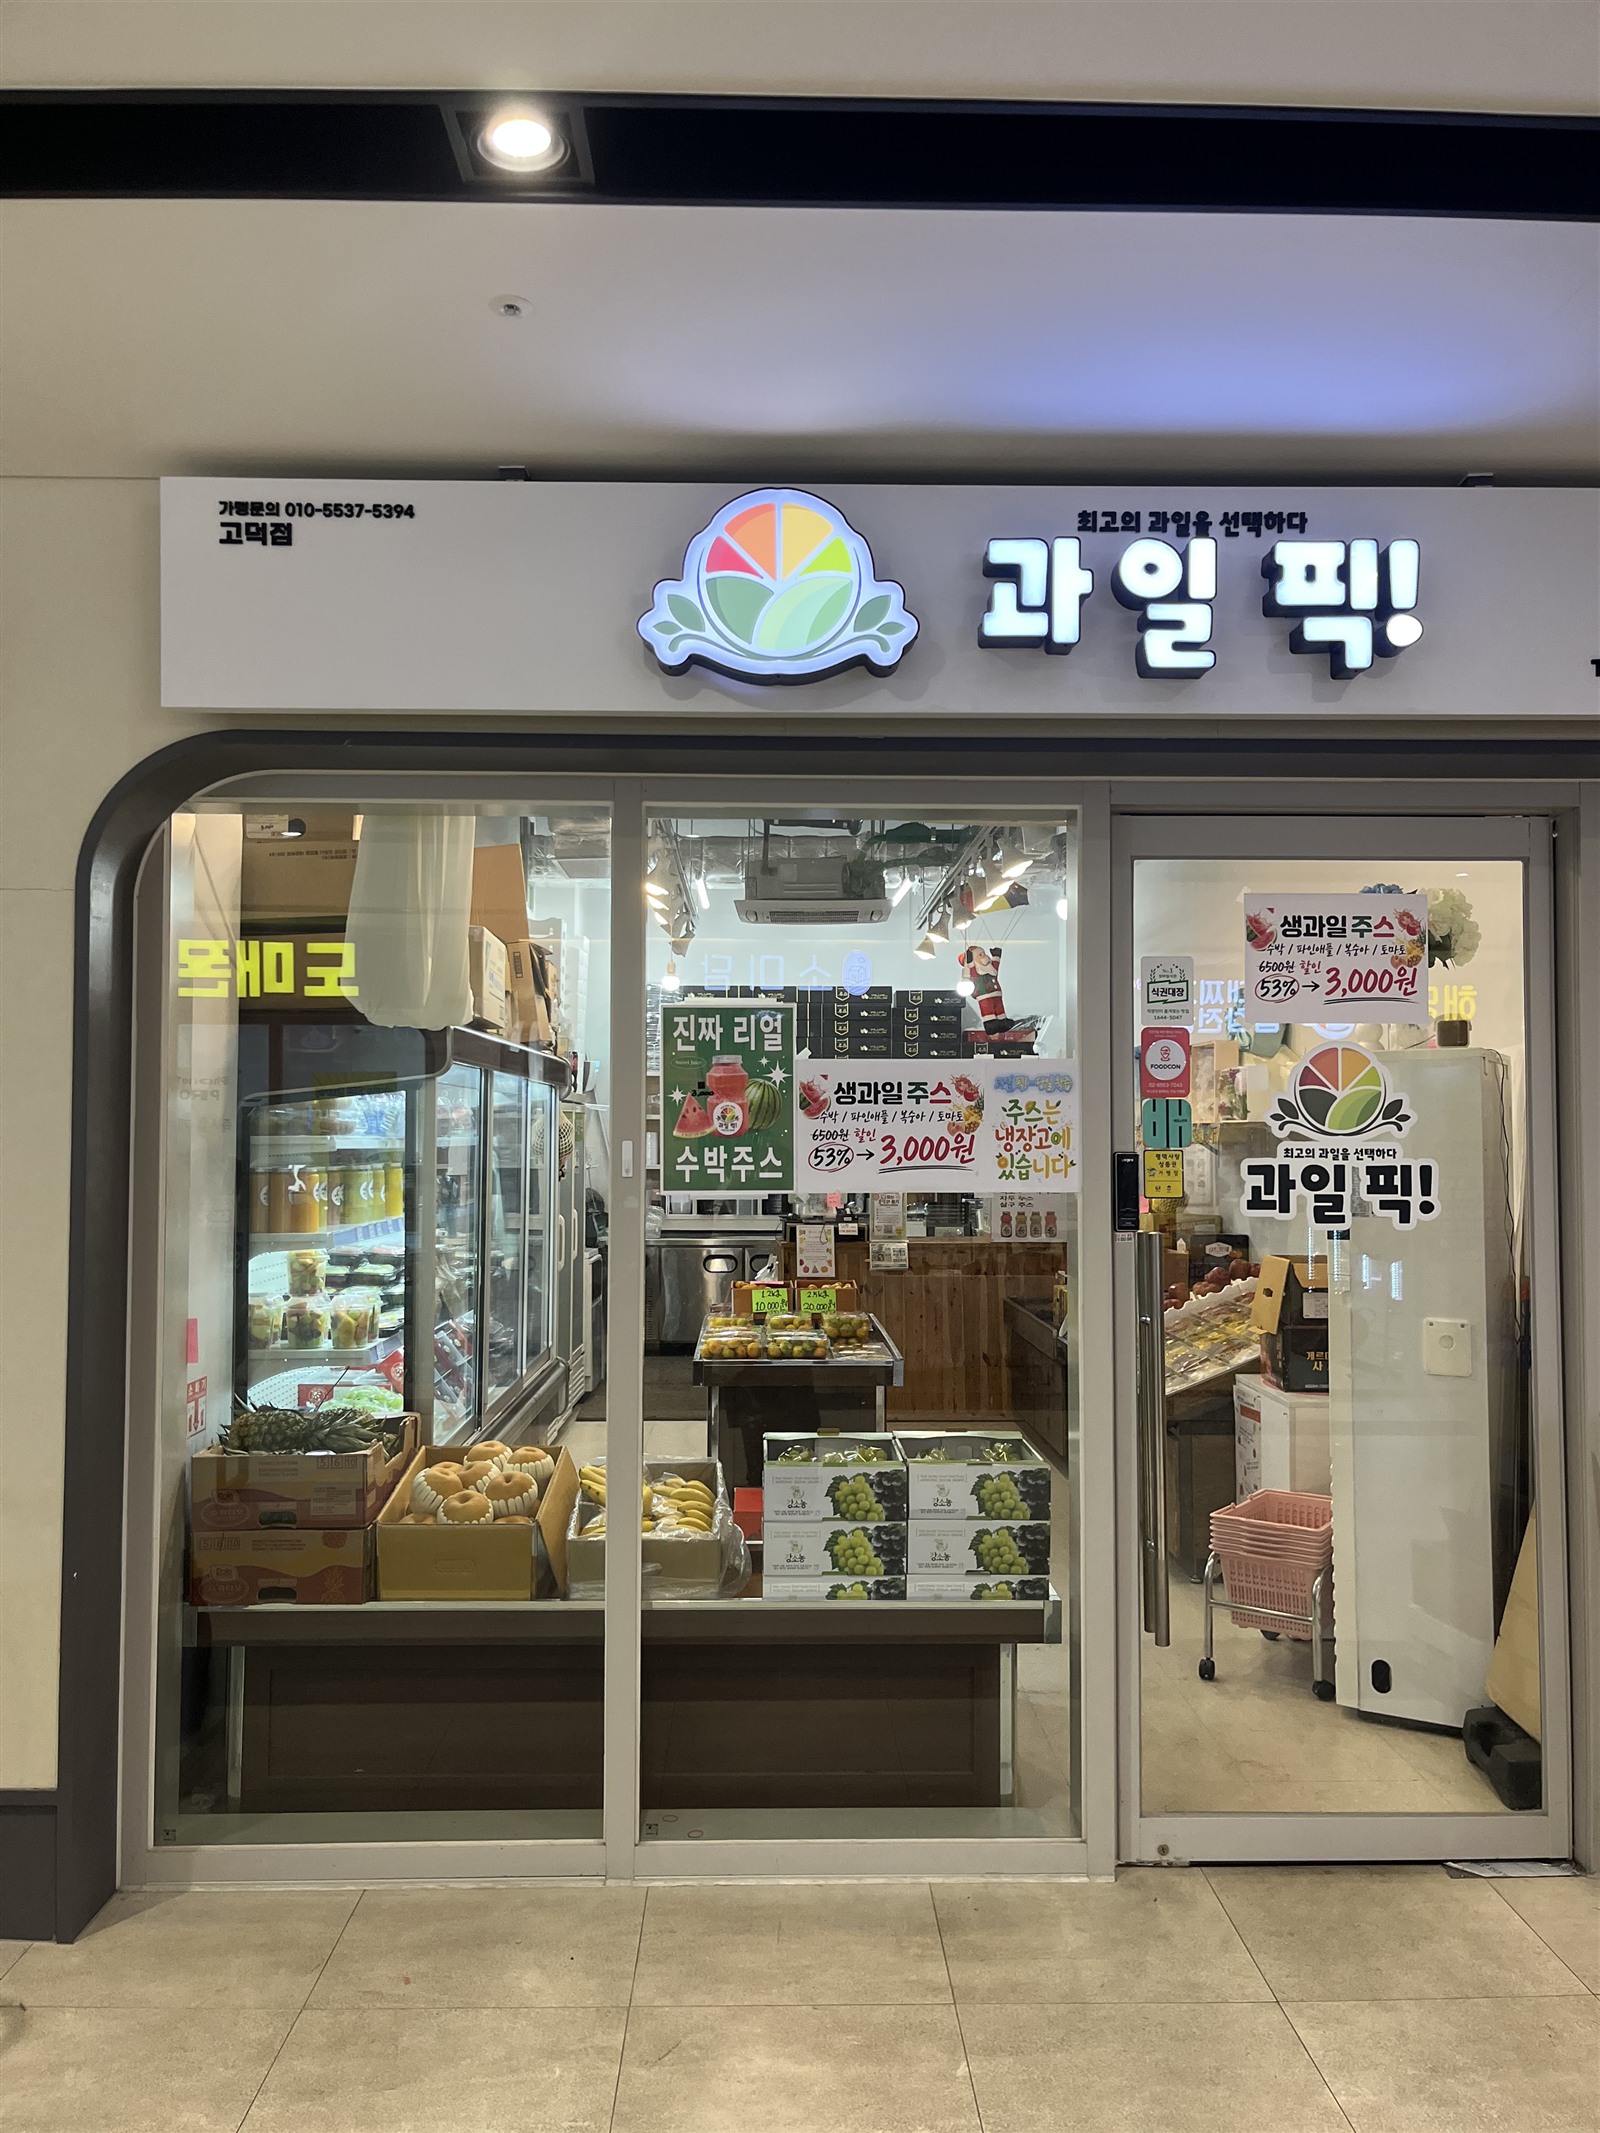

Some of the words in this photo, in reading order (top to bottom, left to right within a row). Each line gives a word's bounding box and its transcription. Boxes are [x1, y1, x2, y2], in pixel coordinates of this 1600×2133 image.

[218, 500, 280, 517] 가맹문의
[284, 502, 415, 519] 010-5537-5394
[218, 521, 293, 546] 고덕점
[1077, 510, 1141, 533] 최고의
[1148, 511, 1213, 537] 과일을
[1219, 511, 1308, 537] 선택하다
[979, 537, 1218, 677] 과일
[1262, 538, 1424, 679] 픽!
[1266, 943, 1286, 956] 수박
[1296, 943, 1334, 956] 파인애플
[1344, 943, 1370, 956] 복숭아
[1380, 944, 1407, 955] 토마토
[1258, 960, 1296, 974] 6500원
[1299, 959, 1322, 975] 할인
[1151, 987, 1185, 997] 식권대장
[1259, 978, 1297, 998] 53%
[1324, 966, 1419, 997] 3,000원
[672, 1014, 724, 1051] 진짜
[733, 1014, 783, 1052] 리얼
[820, 1111, 839, 1124] 수박
[850, 1110, 889, 1124] 파인애플
[900, 1111, 926, 1124] 복숭아
[937, 1110, 964, 1122] 토마토
[1006, 1099, 1062, 1125] 주스는
[811, 1129, 850, 1142] 6500원
[854, 1128, 876, 1143] 할인
[995, 1125, 1071, 1152] 냉장고에
[813, 1147, 851, 1167] 53%
[880, 1132, 976, 1165] 3,000원
[1283, 1147, 1316, 1159] 최고의
[1318, 1147, 1350, 1161] 과일을
[1353, 1148, 1397, 1162] 선택하다
[675, 1145, 783, 1183] 수박주스
[996, 1152, 1073, 1180] 있습니다
[1246, 1164, 1346, 1224] 과일
[1366, 1164, 1435, 1224] 픽!
